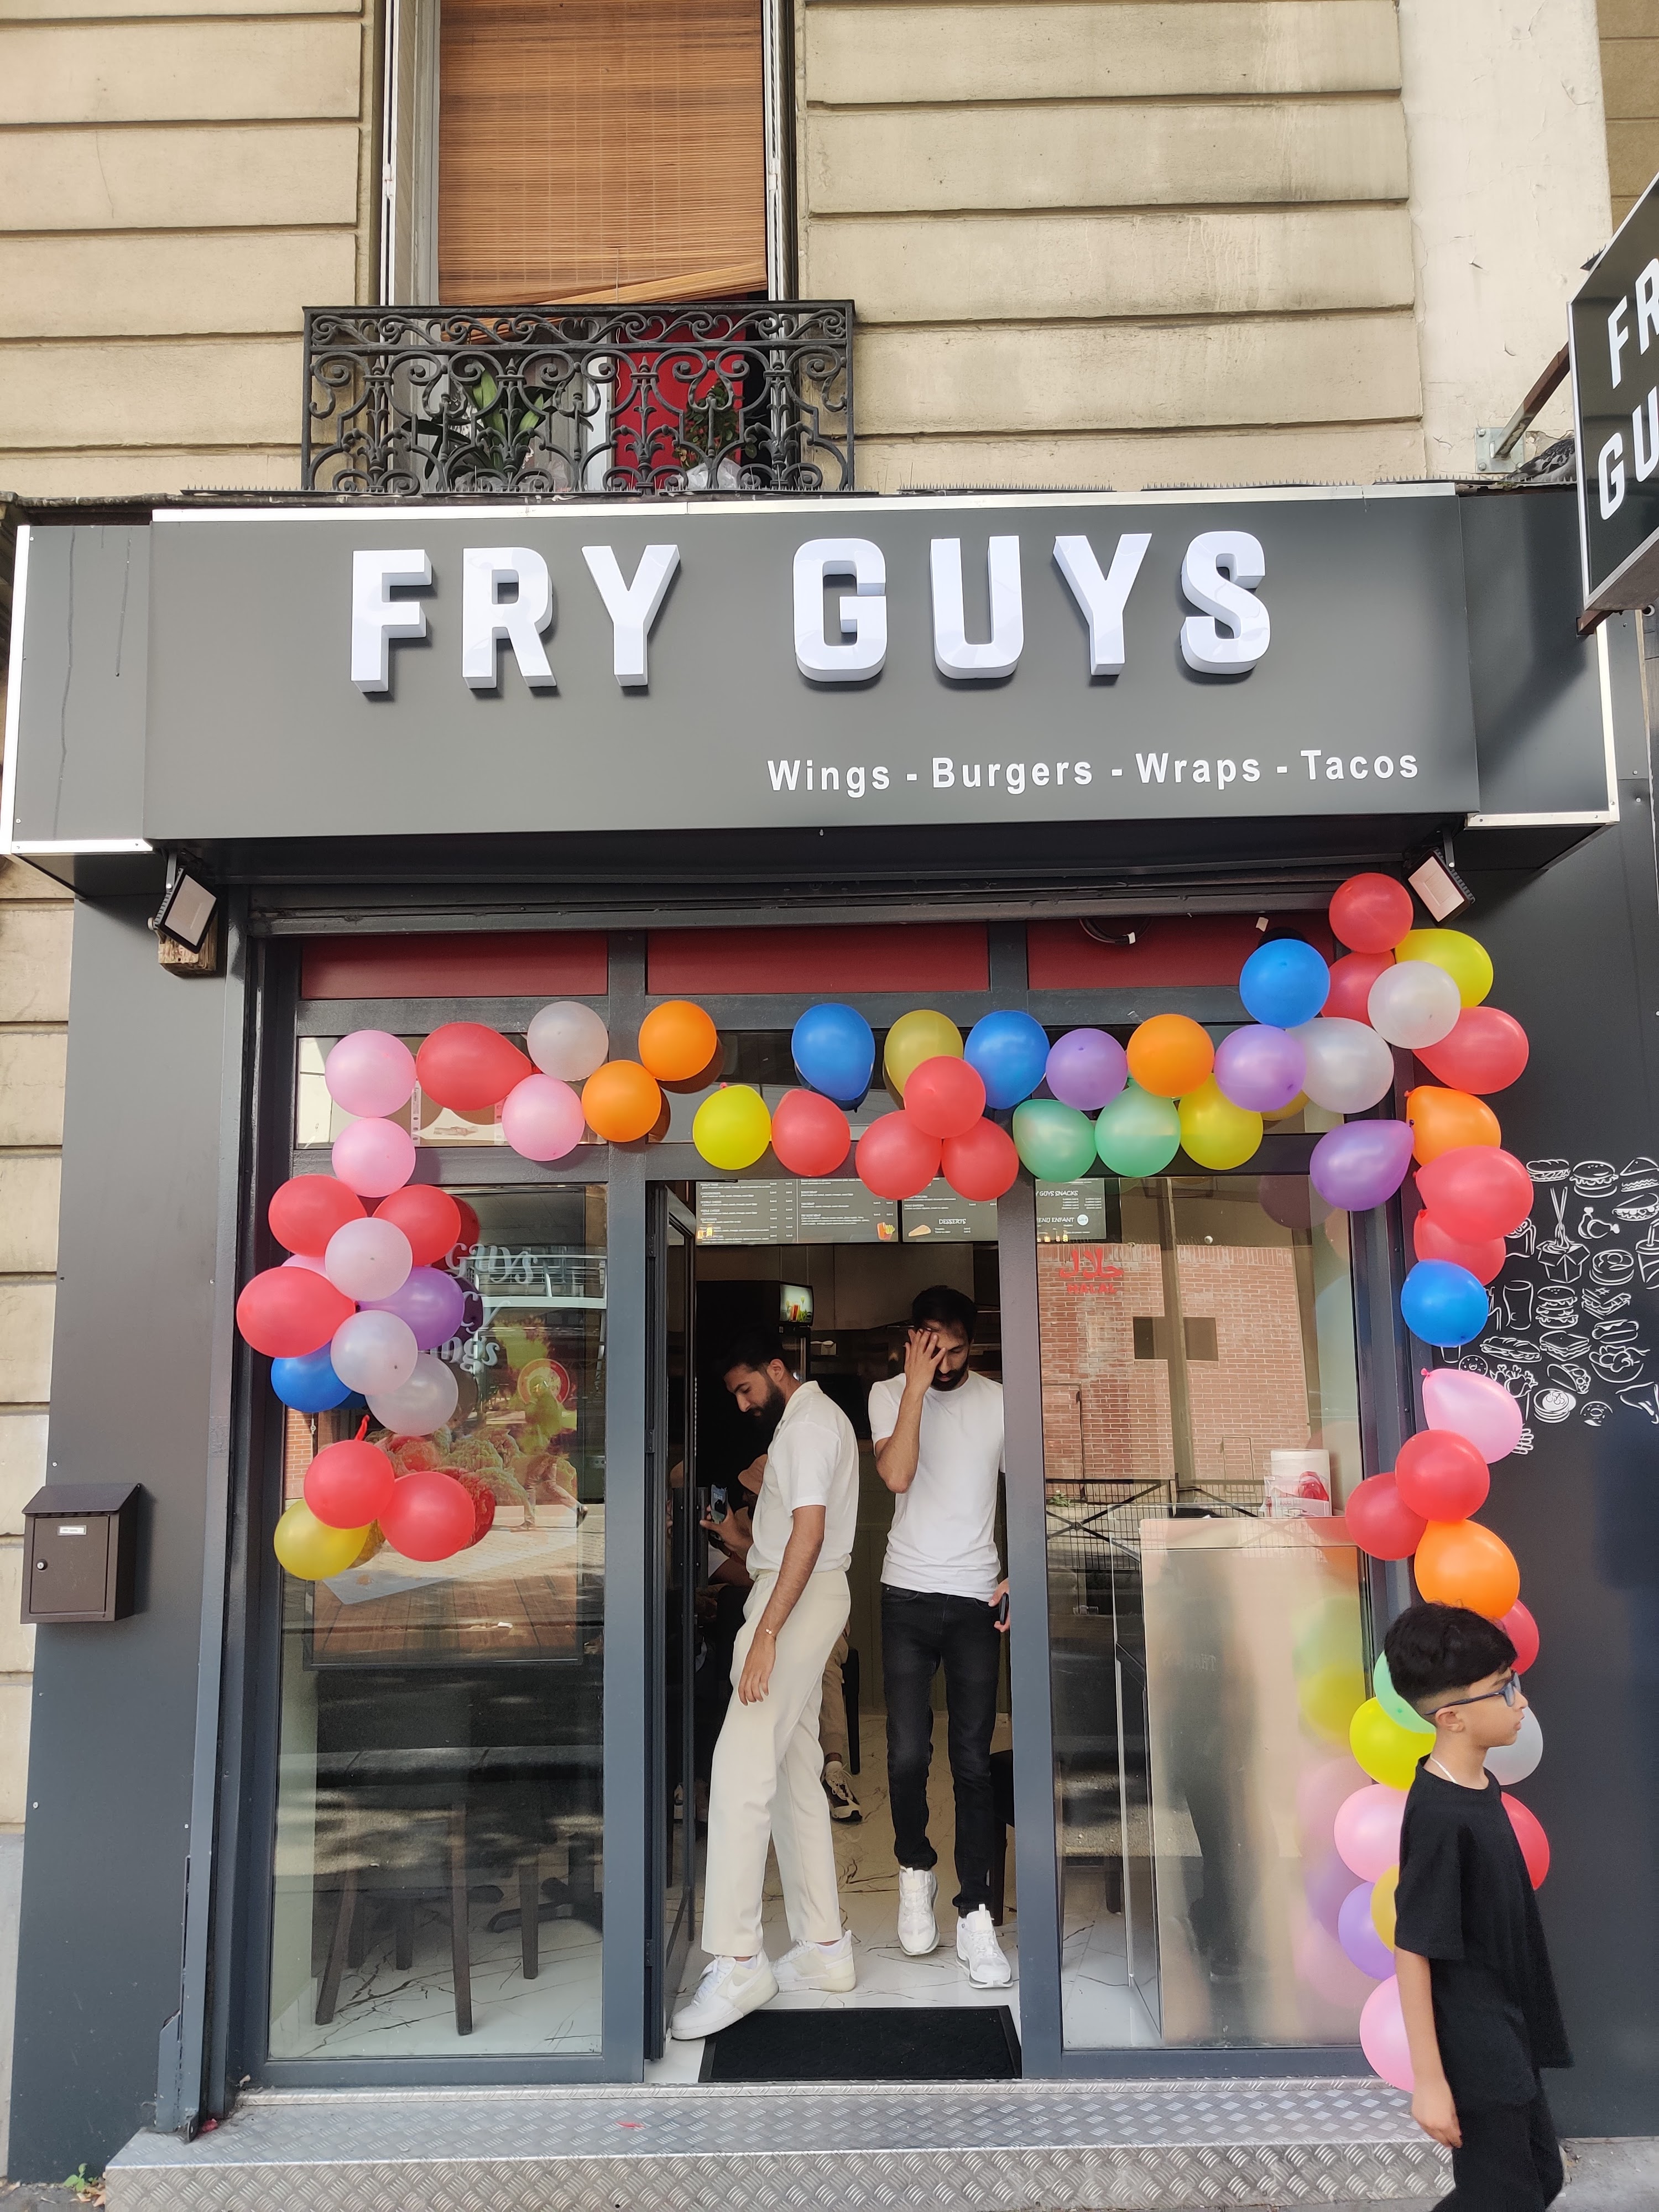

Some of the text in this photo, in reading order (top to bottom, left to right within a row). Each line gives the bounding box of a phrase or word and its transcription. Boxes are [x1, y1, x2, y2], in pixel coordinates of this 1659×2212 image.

[1598, 385, 1659, 520] GU
[351, 530, 1271, 692] FRY GUYS
[767, 759, 890, 799] Wings
[932, 757, 1093, 795] Burgers
[1135, 753, 1261, 790] Wraps
[1300, 749, 1418, 780] Tacos
[1059, 1247, 1124, 1279] حلال
[1067, 1282, 1118, 1295] HALAL
